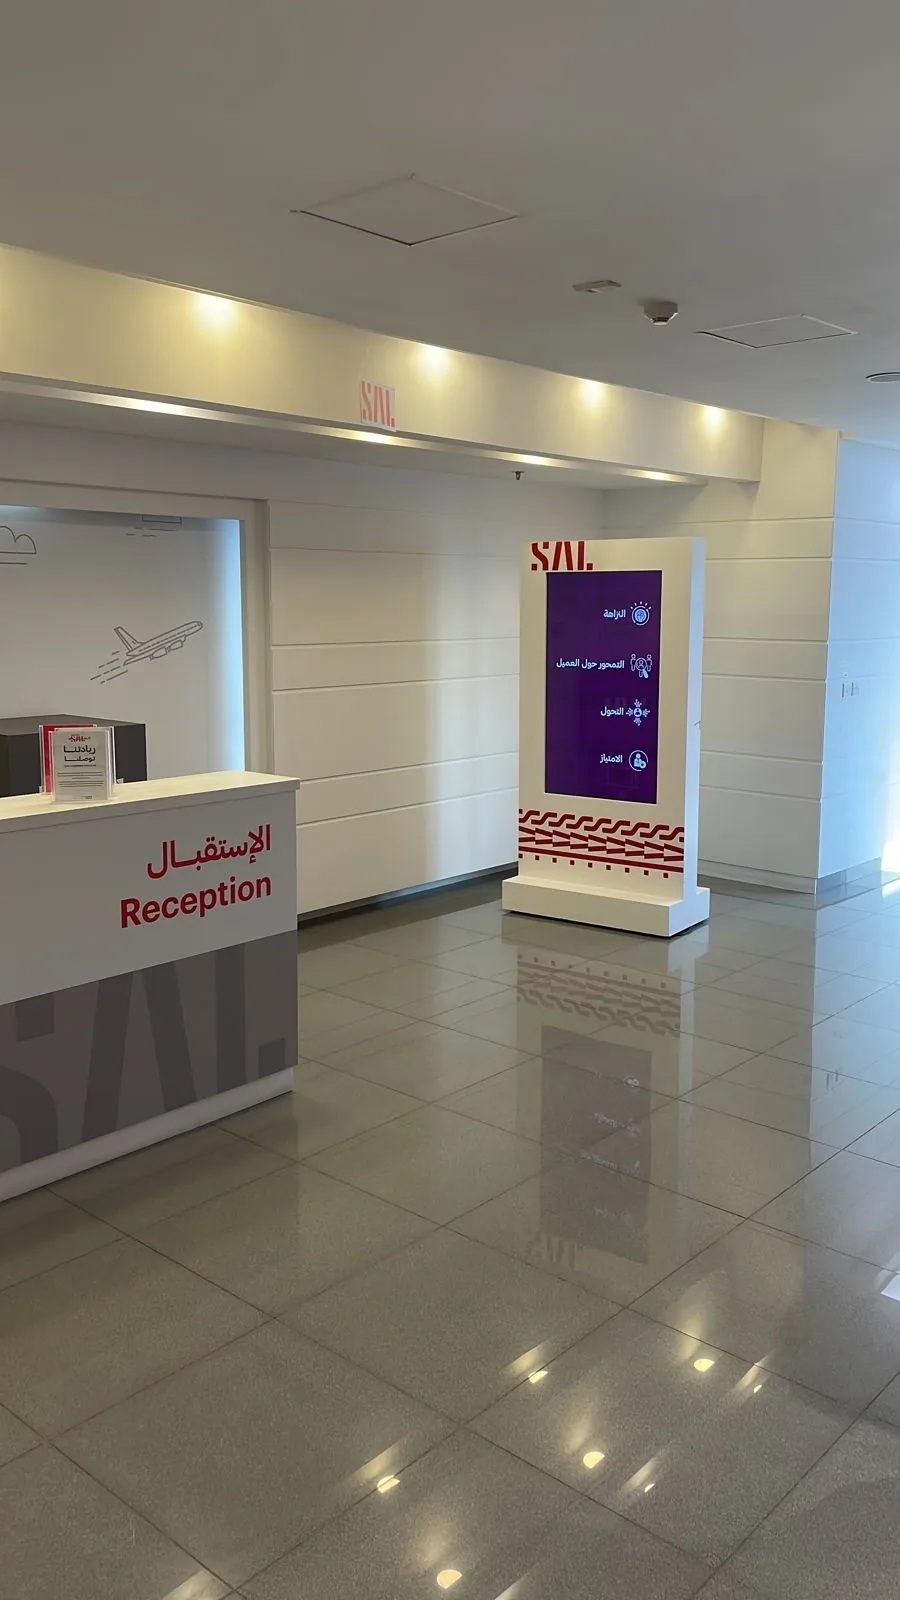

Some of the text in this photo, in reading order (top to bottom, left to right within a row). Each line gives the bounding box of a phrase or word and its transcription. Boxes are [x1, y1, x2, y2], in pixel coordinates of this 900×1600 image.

[361, 380, 396, 428] SAL
[531, 541, 593, 571] SAL
[603, 609, 626, 620] النزاهة
[556, 658, 625, 670] التمحور حول العميل
[600, 706, 624, 716] التحول
[599, 753, 623, 764] الامتياز
[147, 824, 271, 878] الإستقبال
[120, 876, 271, 928] Reception
